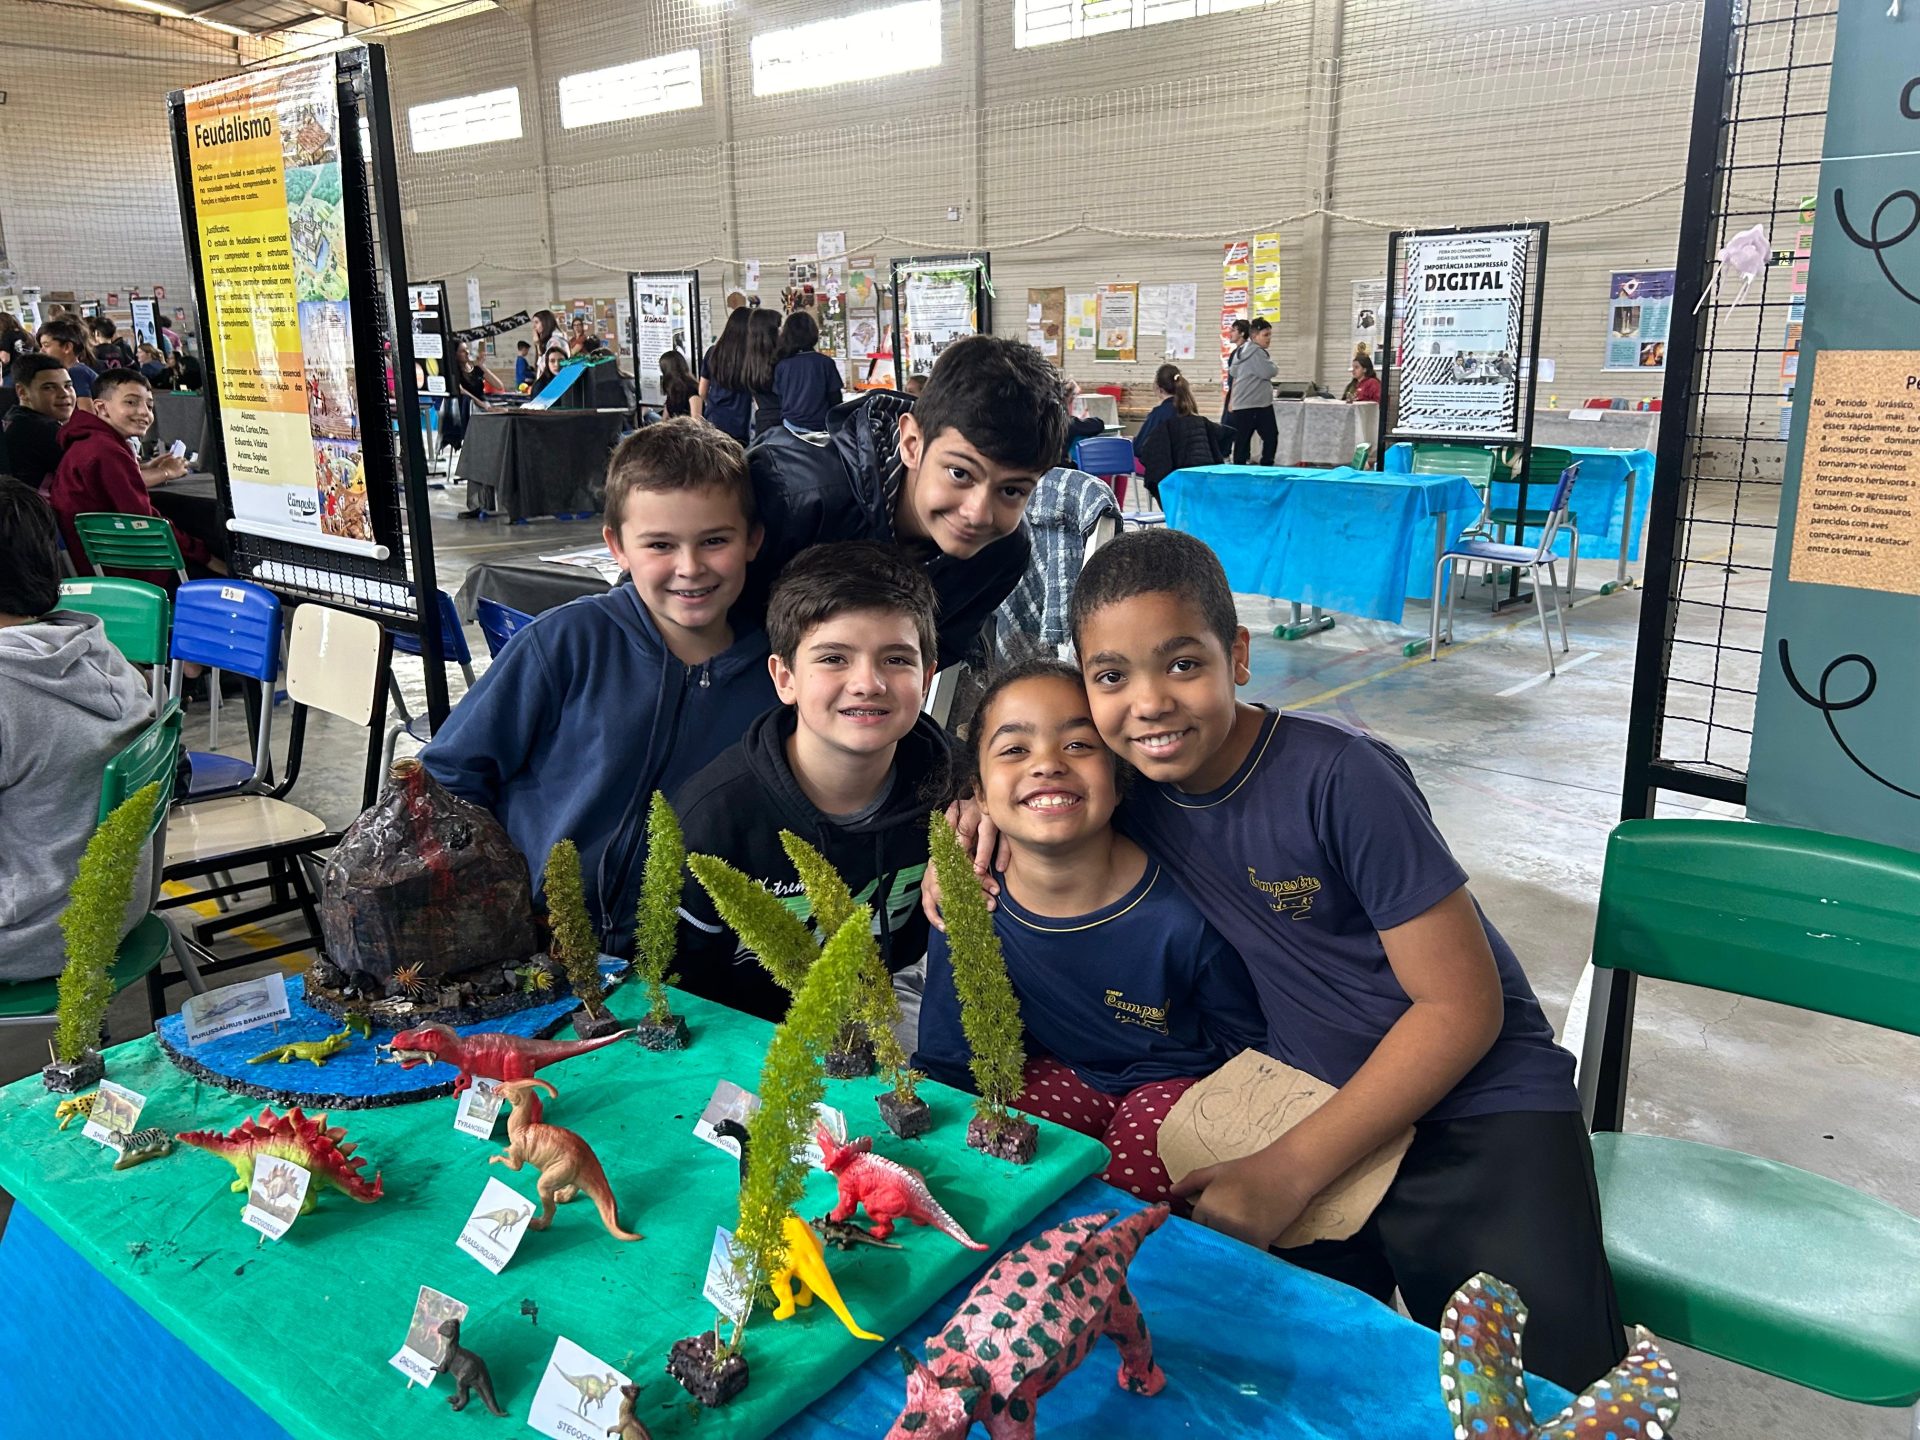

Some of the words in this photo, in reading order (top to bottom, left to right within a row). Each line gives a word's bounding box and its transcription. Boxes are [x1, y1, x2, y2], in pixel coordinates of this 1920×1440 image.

[194, 115, 271, 148] Feudalismo
[268, 233, 287, 242] essencial
[1474, 260, 1508, 268] IMPRESSÃO
[1425, 271, 1503, 291] DIGITAL
[1814, 399, 1826, 407] No
[1824, 411, 1872, 419] dinossauros
[1849, 423, 1903, 433] rapidamente,
[1820, 445, 1868, 454] dinossauros
[1818, 460, 1868, 469] tornaram-se
[1870, 463, 1906, 471] violentos
[1816, 474, 1853, 483] forçando
[1815, 488, 1864, 498] tornarem-se
[1866, 492, 1907, 502] agressivos
[1813, 502, 1848, 511] também.
[1851, 504, 1861, 512] Os
[1863, 506, 1911, 517] dinossauros
[1810, 517, 1850, 526] parecidos
[1870, 522, 1888, 530] aves
[1809, 531, 1856, 540] começaram
[1875, 537, 1910, 546] destacar
[1807, 545, 1829, 553] entre
[191, 1020, 243, 1041] PURUSSAURUS
[243, 1008, 287, 1025] BRASILIENSE
